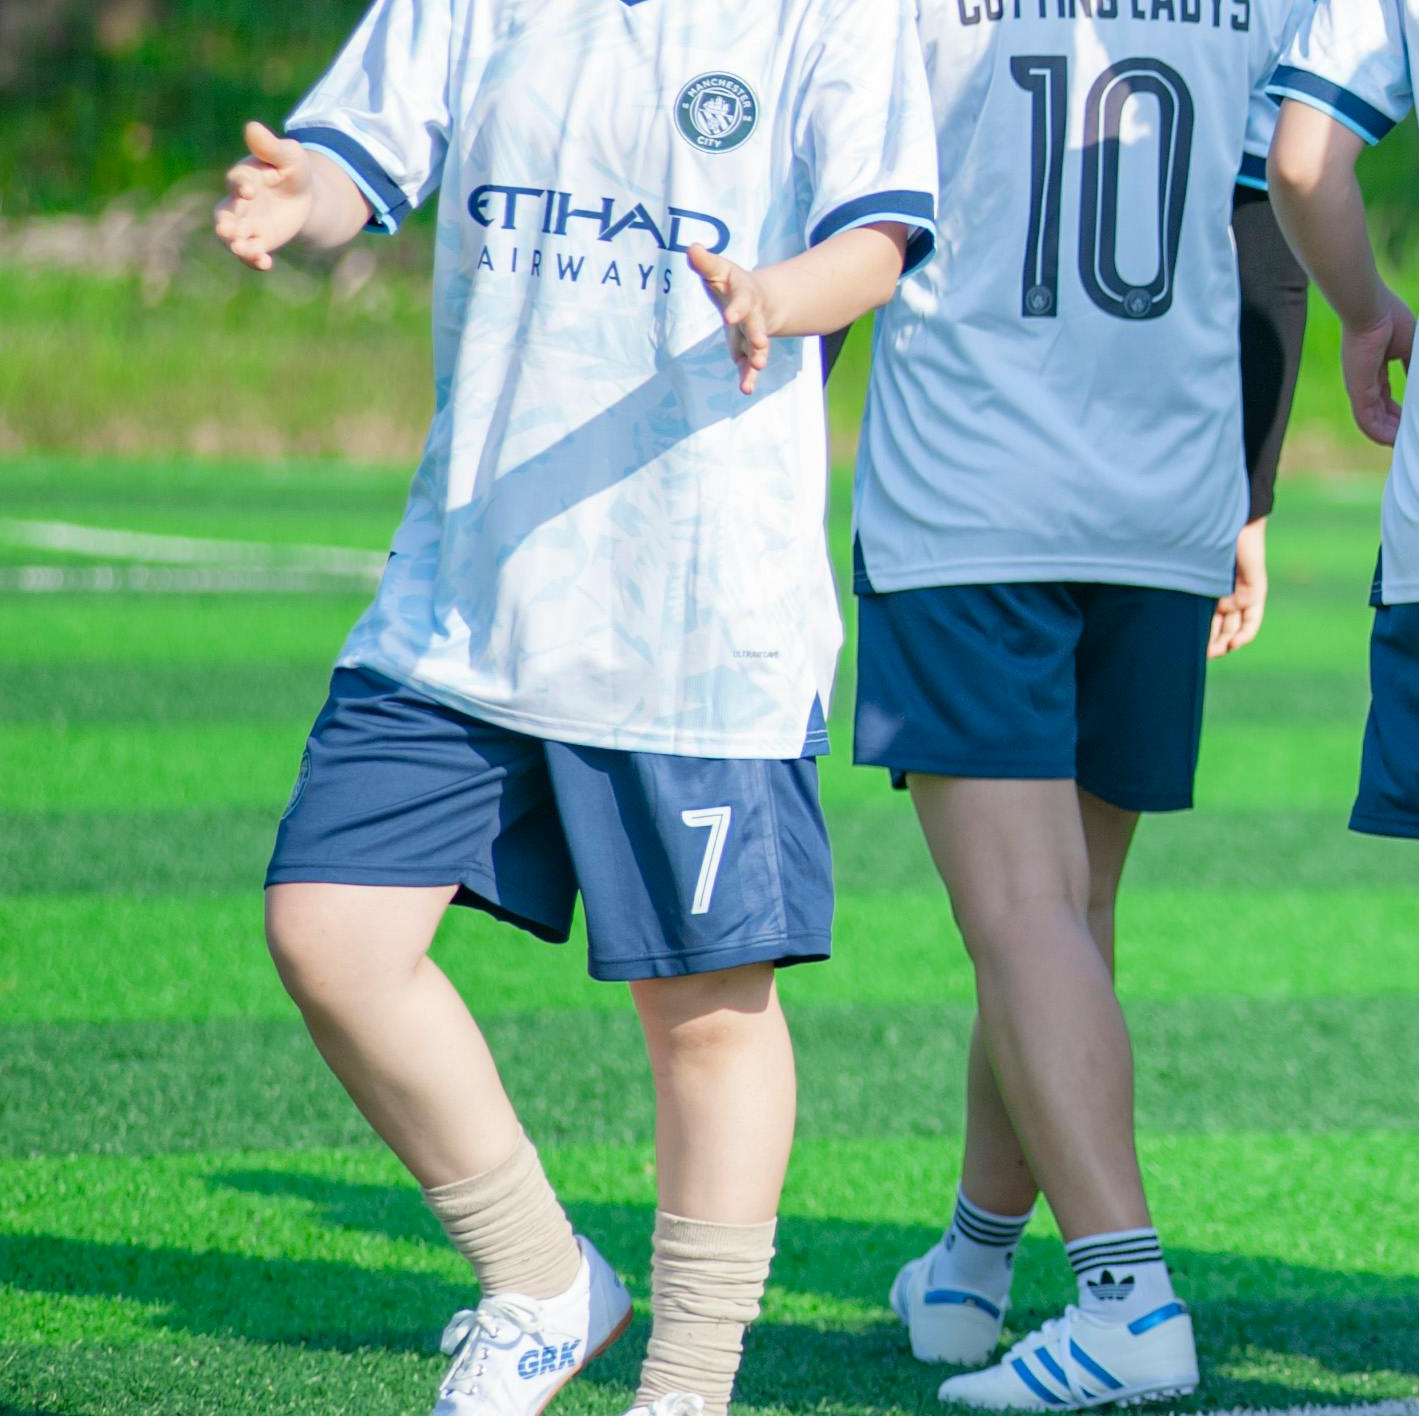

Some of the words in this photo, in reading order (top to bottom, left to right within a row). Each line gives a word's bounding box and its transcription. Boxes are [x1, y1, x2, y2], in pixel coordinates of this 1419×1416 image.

[688, 78, 752, 108] MANCHESTER
[697, 136, 722, 148] CITY
[1010, 55, 1194, 322] 10
[467, 184, 731, 255] ETIHAD
[477, 245, 672, 294] AIRWAYS
[681, 806, 731, 915] 7
[518, 1338, 582, 1380] GRK
